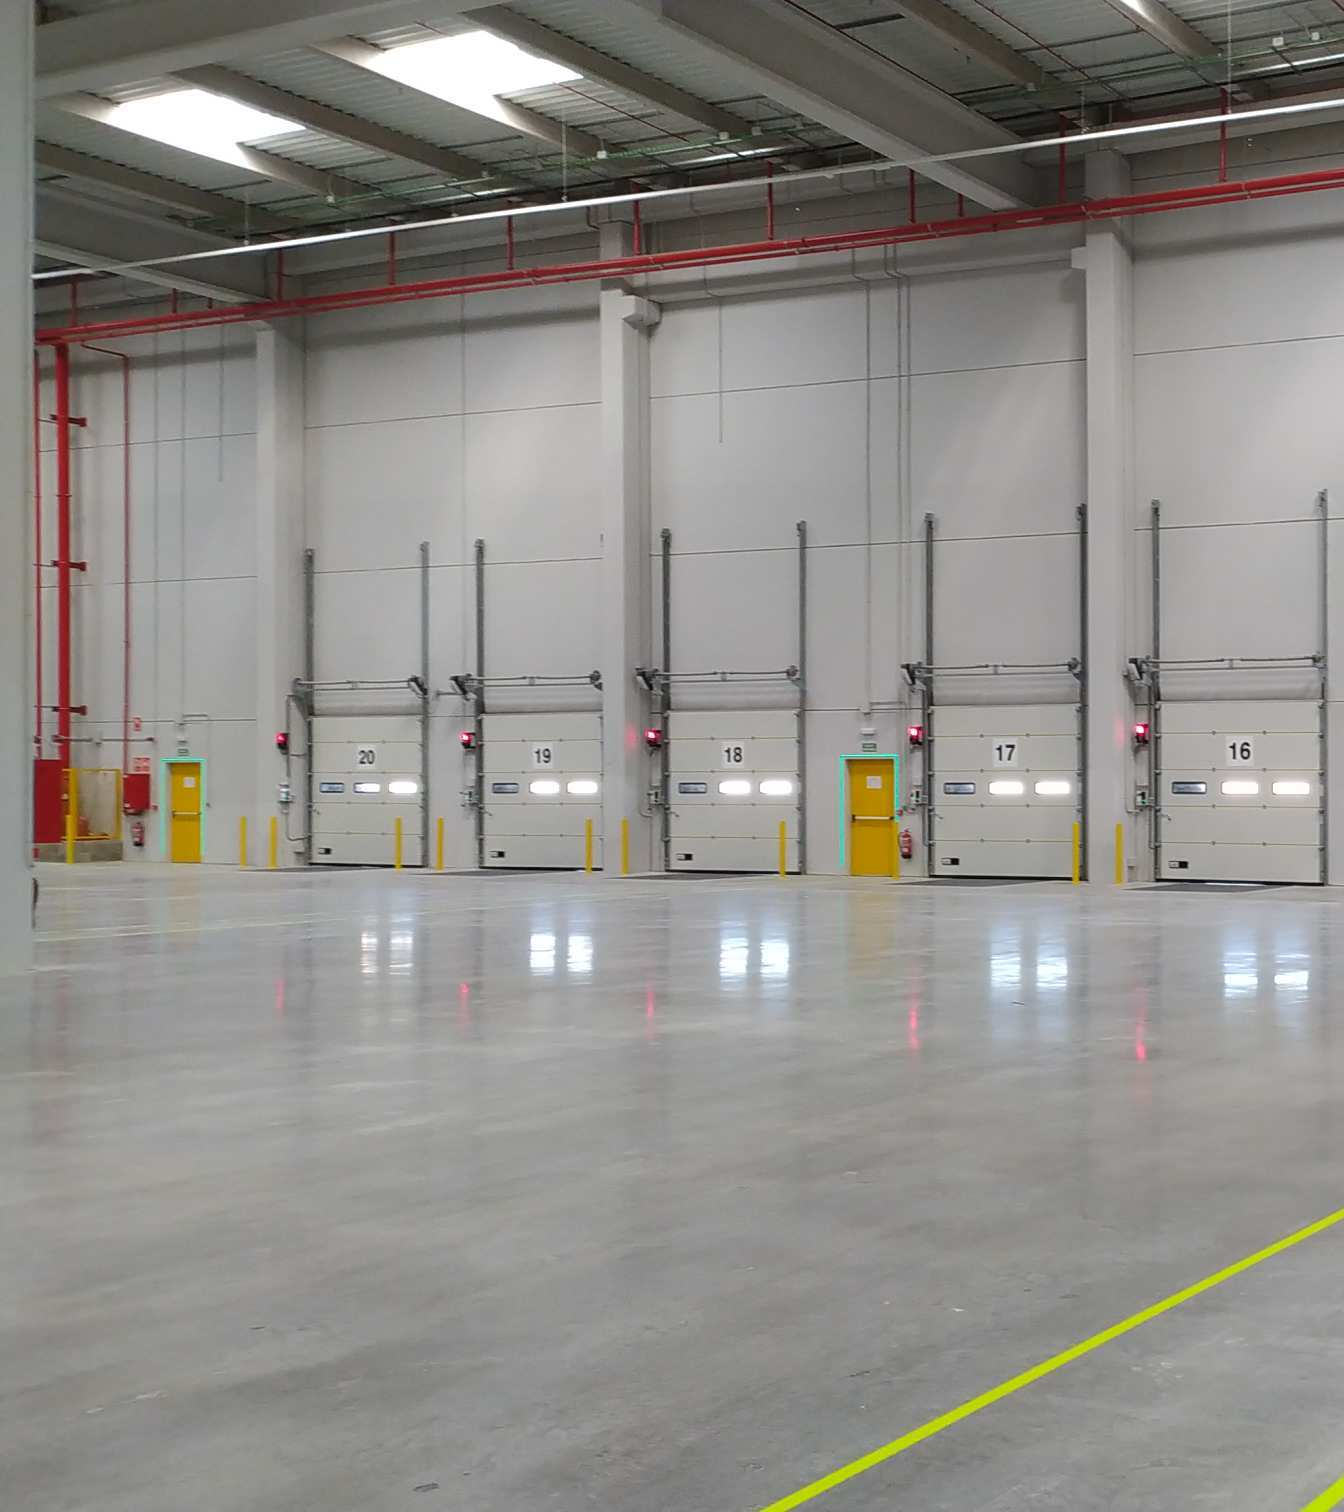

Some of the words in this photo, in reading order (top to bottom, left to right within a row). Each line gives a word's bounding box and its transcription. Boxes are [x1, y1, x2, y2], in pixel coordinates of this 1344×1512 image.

[359, 749, 376, 765] 20
[535, 748, 551, 764] 19
[724, 747, 743, 763] 18
[995, 744, 1016, 761] 17
[1229, 742, 1251, 760] 16
